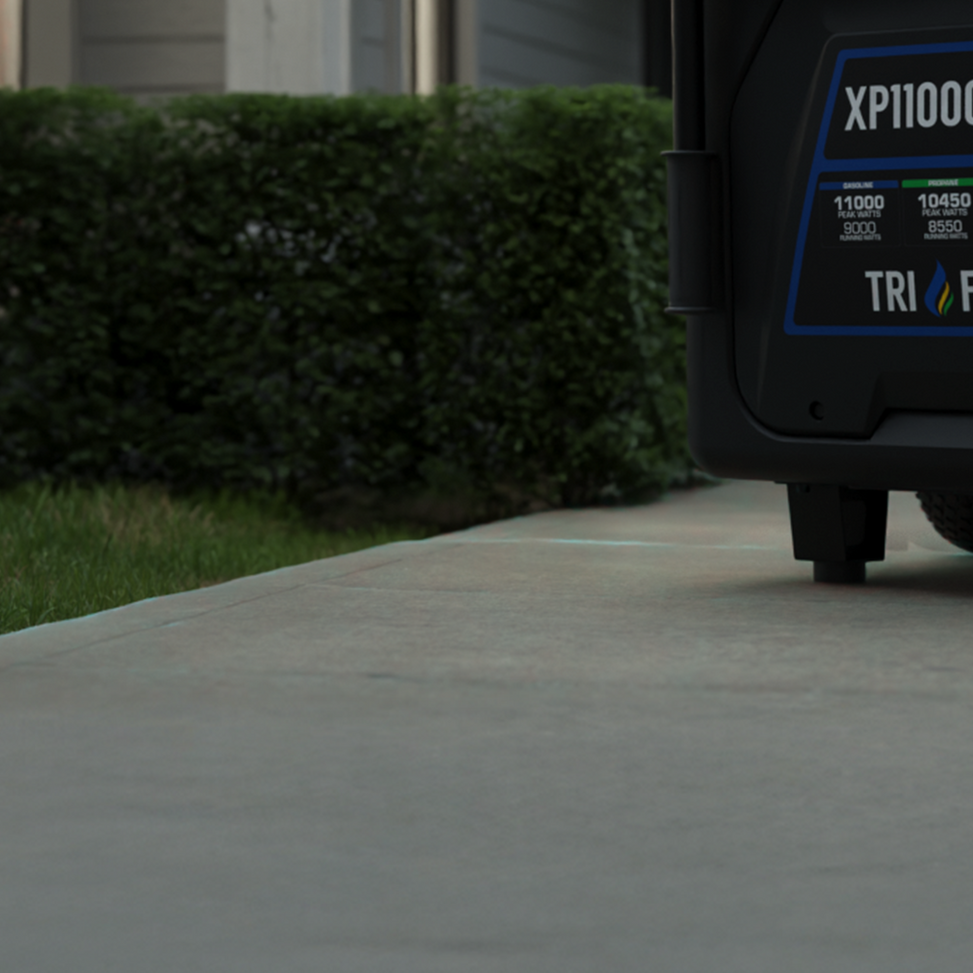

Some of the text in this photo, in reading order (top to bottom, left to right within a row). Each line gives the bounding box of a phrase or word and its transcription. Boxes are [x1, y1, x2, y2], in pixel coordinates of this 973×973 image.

[842, 181, 874, 189] GASOLINE
[928, 179, 958, 187] PROPANE
[834, 195, 885, 211] 11000
[918, 192, 971, 209] 10450
[838, 210, 881, 219] PEAK WATTS
[922, 208, 968, 217] PEAK WATTS
[843, 221, 877, 235] 9000
[928, 219, 963, 233] 8550
[864, 233, 881, 241] WATTS
[949, 232, 968, 240] WATTS
[864, 270, 917, 313] TRI
